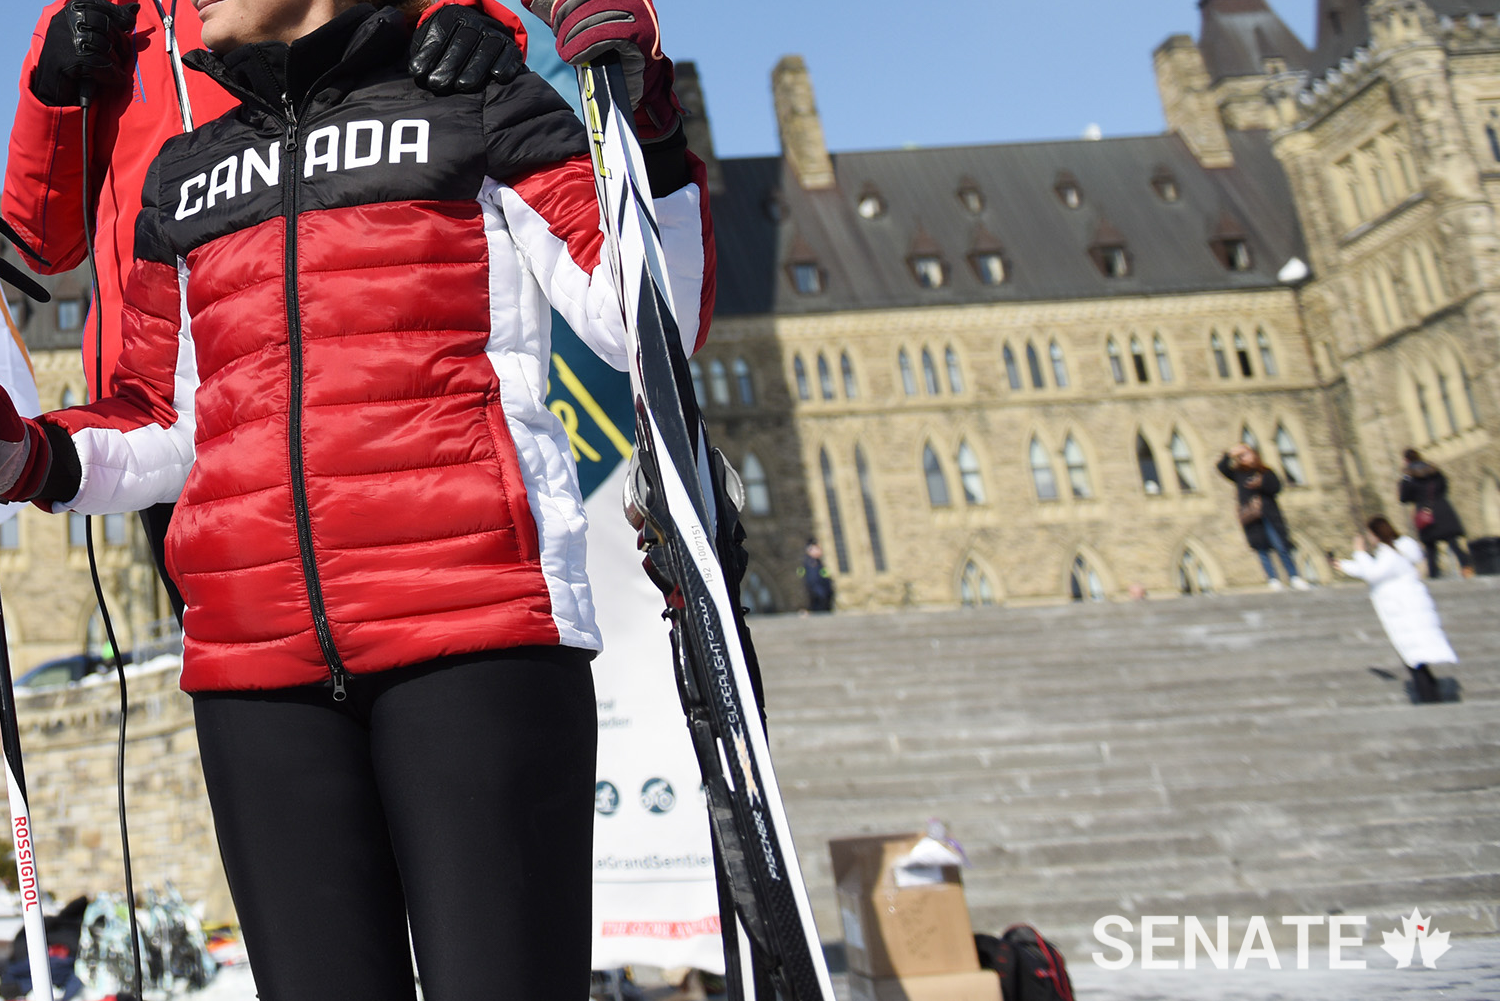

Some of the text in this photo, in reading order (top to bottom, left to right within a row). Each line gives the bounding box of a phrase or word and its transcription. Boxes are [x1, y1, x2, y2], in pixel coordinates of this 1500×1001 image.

[174, 118, 430, 221] CANADA
[691, 524, 714, 584] 192 1007151
[14, 816, 38, 912] ROSSIGNOL
[752, 810, 781, 881] FISCHER
